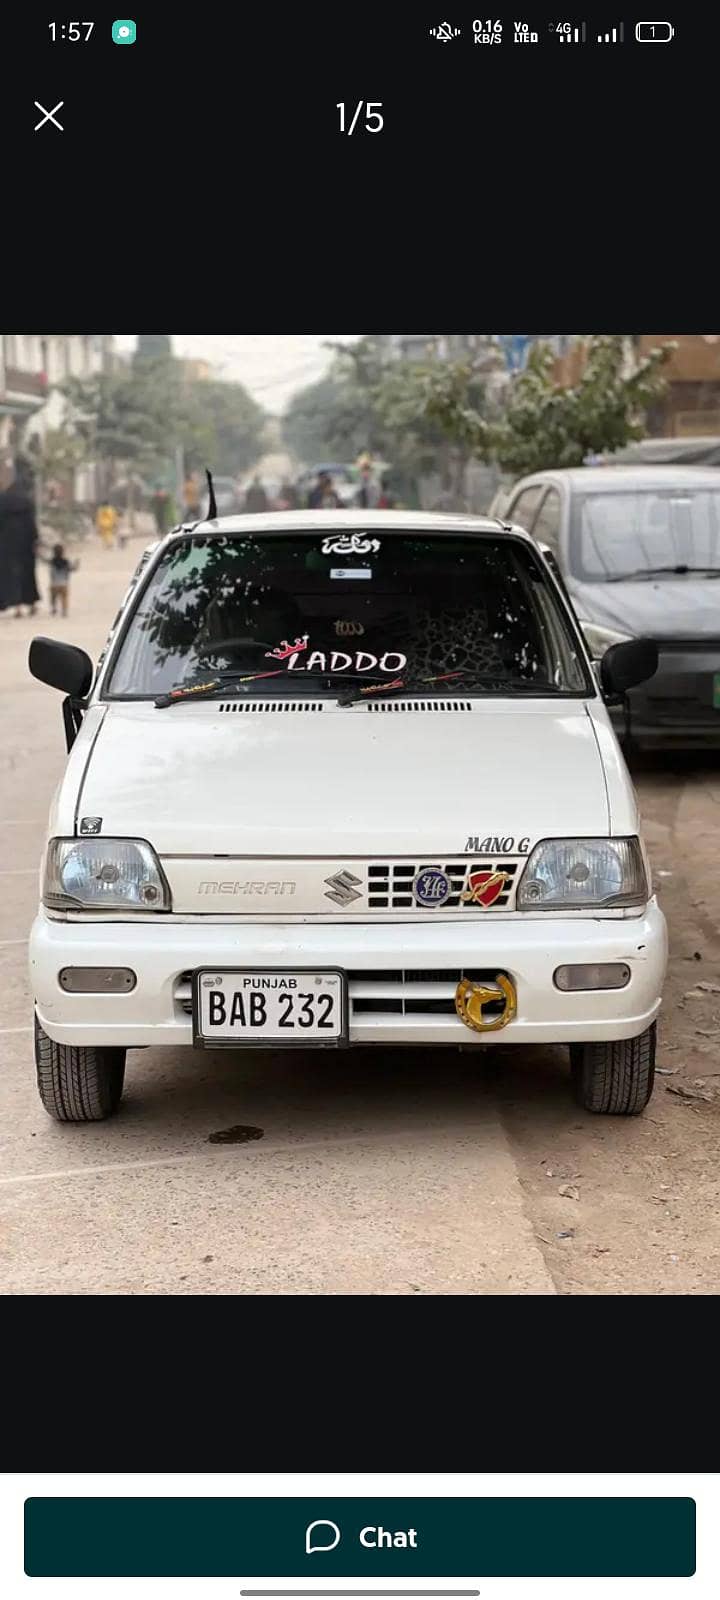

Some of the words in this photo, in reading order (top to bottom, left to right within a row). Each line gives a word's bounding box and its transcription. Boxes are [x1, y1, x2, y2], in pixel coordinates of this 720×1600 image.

[287, 651, 407, 672] LADDO
[464, 837, 515, 853] MANO
[518, 837, 530, 853] G
[197, 881, 297, 895] MEHRAN
[243, 978, 298, 989] PUNJAB
[209, 990, 268, 1027] BAB
[278, 992, 335, 1029] 232
